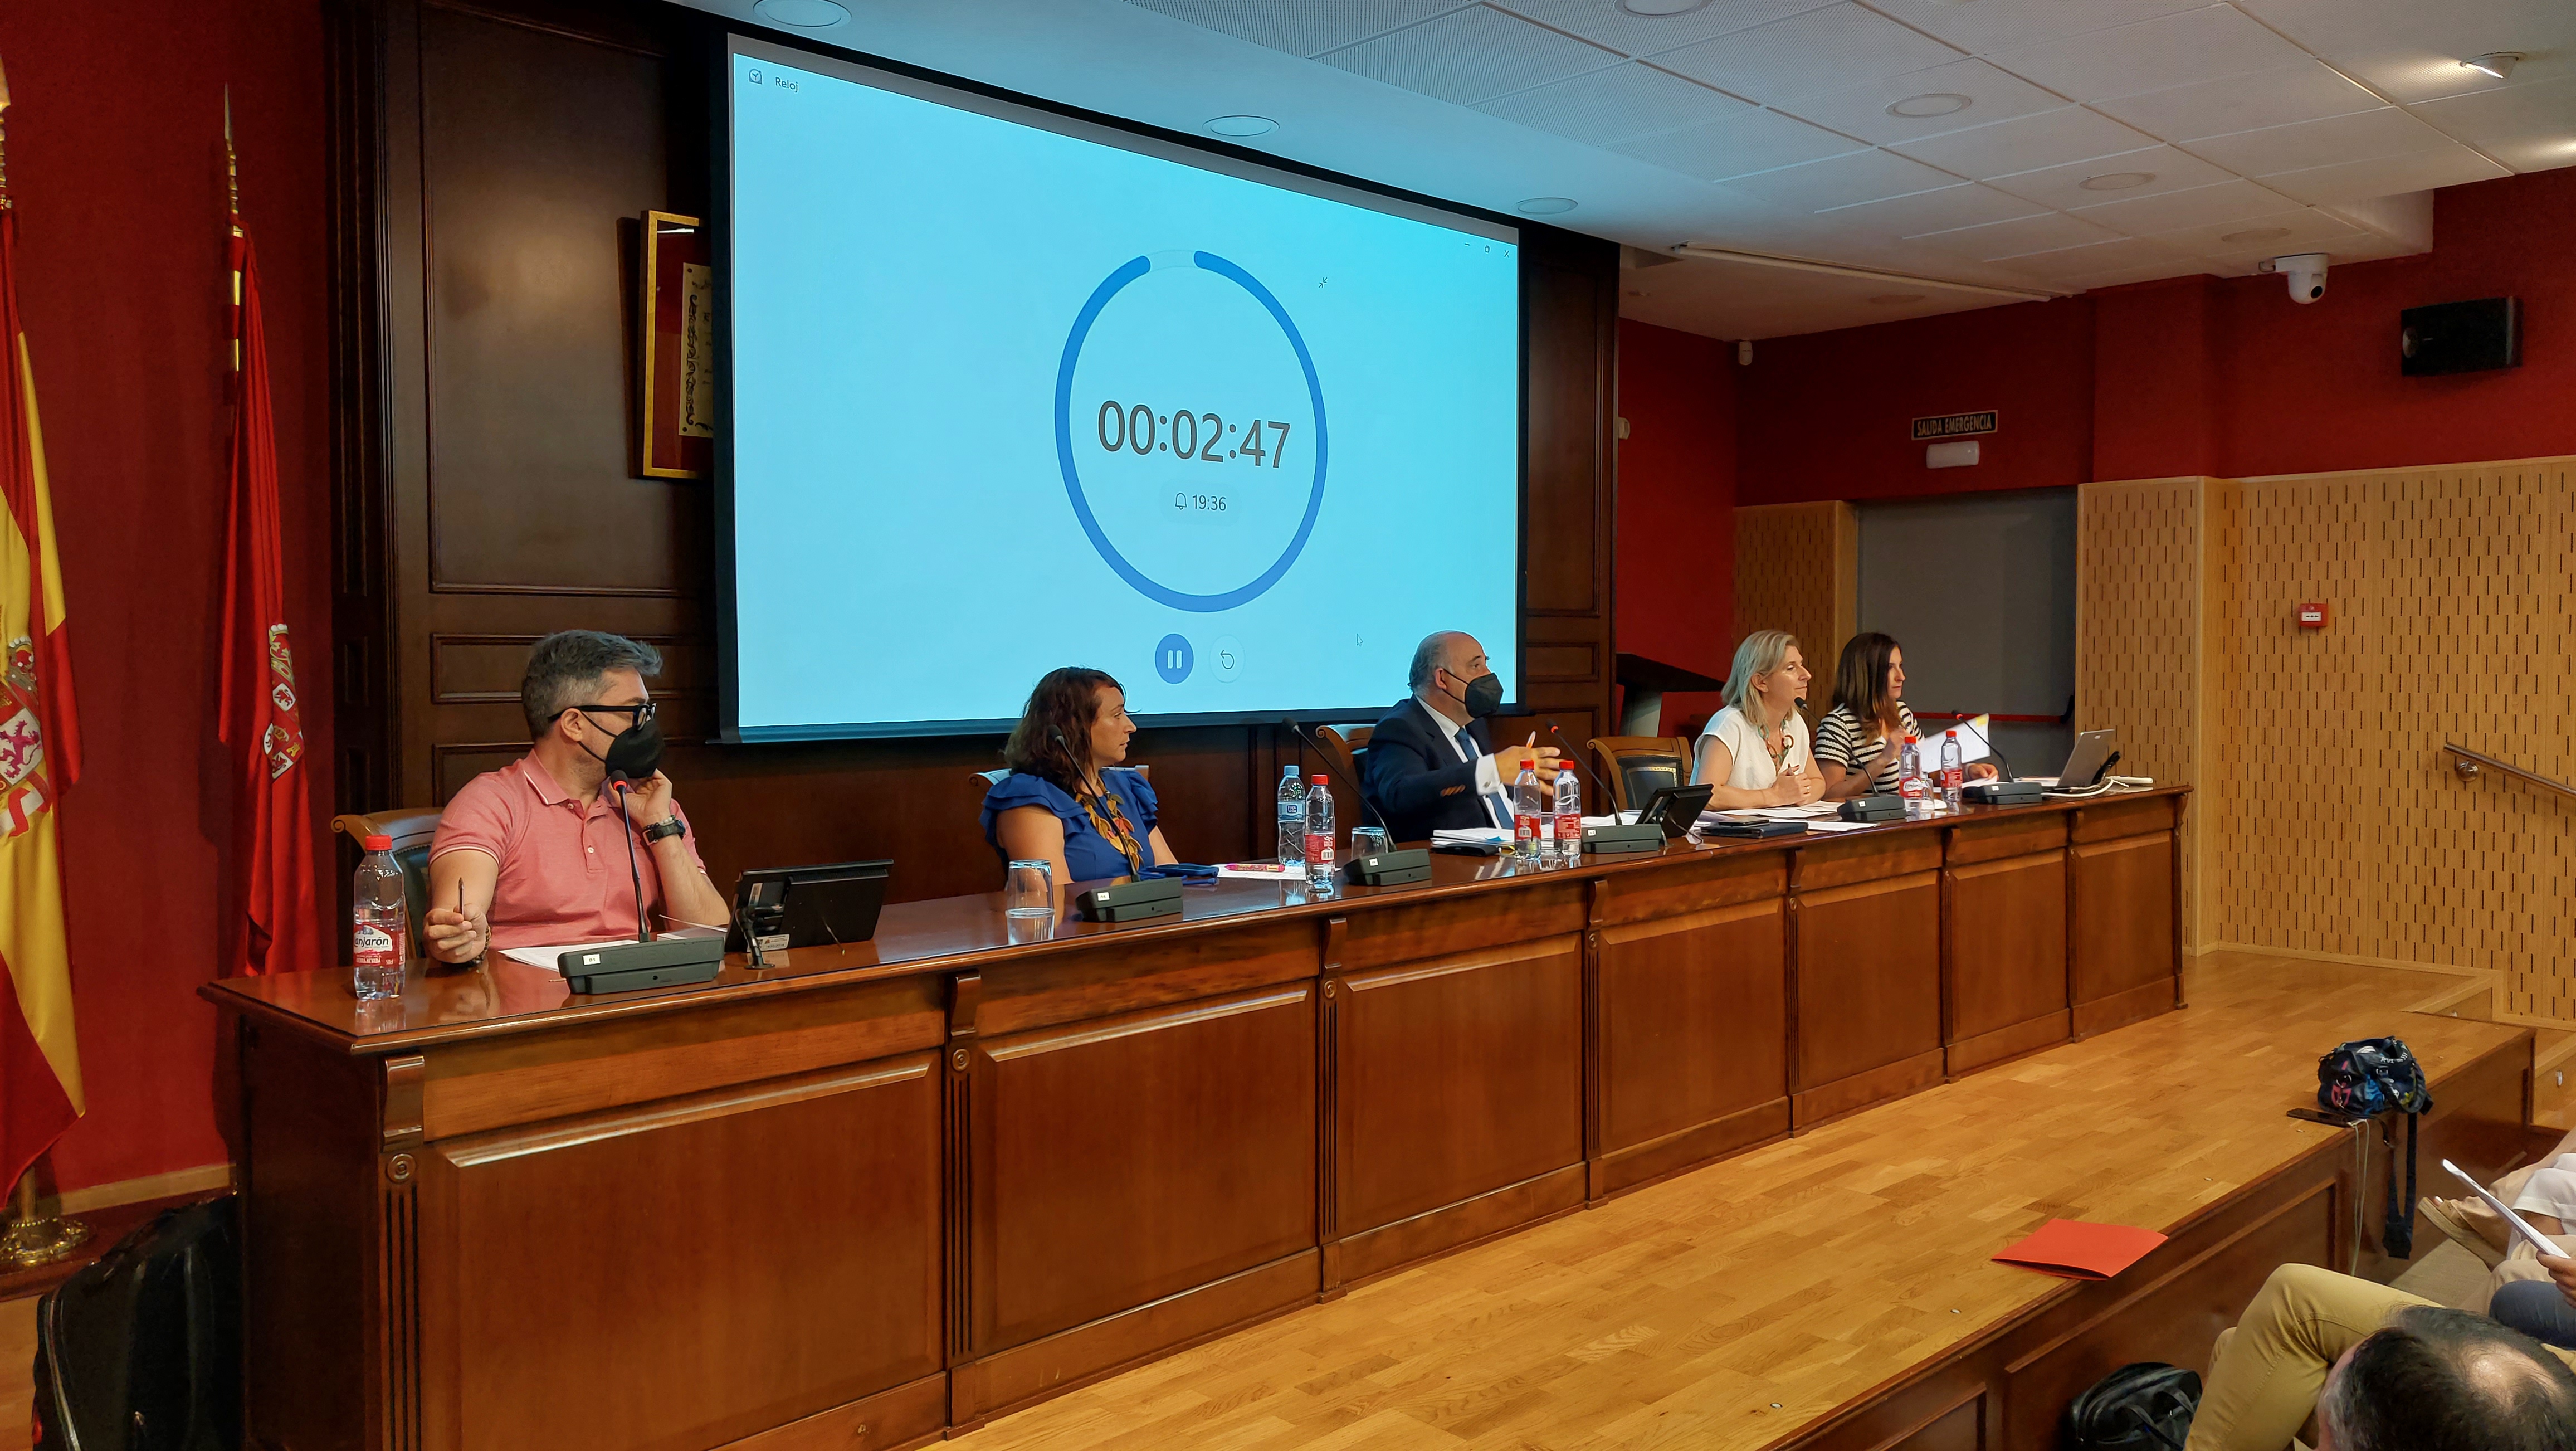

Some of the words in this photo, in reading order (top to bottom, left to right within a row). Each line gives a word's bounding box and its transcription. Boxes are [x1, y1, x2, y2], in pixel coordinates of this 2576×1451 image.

[775, 76, 798, 93] Reloj
[1098, 400, 1290, 468] 00:02:47
[1917, 419, 1943, 436] SALIDA
[1945, 414, 1992, 434] EMERGENCIA
[1192, 494, 1227, 512] 19:36
